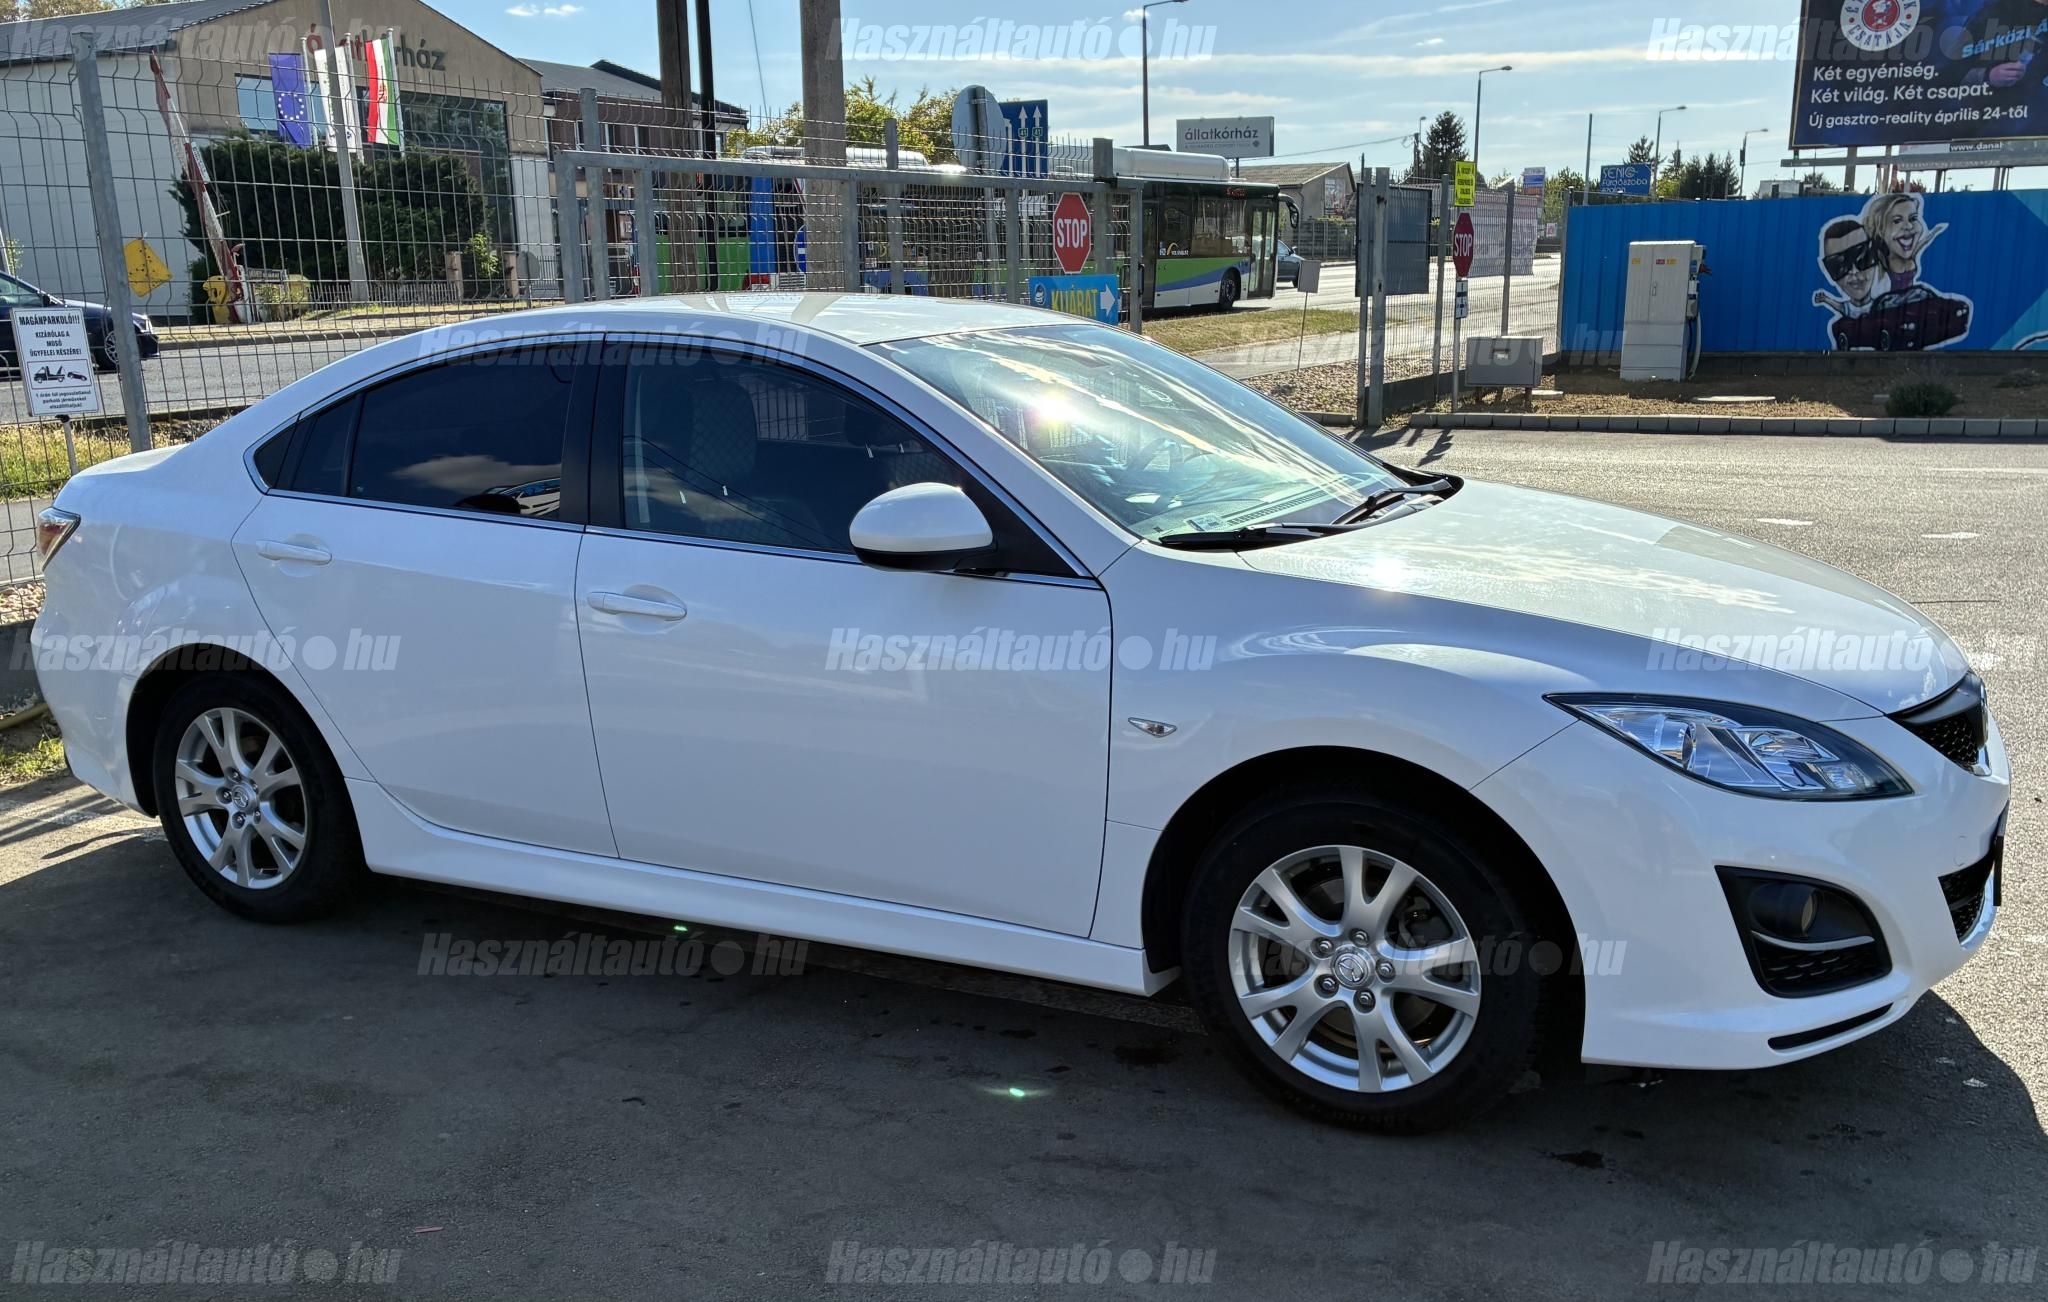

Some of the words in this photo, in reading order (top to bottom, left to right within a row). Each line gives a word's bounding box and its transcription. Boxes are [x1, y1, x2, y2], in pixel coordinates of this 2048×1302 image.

[1813, 66, 1842, 82] Két
[1845, 62, 1939, 83] egyéniség.
[1811, 88, 1839, 104] Két
[1843, 86, 1889, 105] világ.
[1893, 85, 1924, 101] Két
[1927, 82, 1994, 101] csapat.
[1808, 112, 1823, 128] Új
[1825, 110, 1932, 129] gasztro-reality
[1934, 107, 1980, 124] április
[1983, 105, 2029, 121] 24-től
[1184, 126, 1259, 141] állatkórház
[1056, 217, 1088, 249] STOP
[1454, 233, 1473, 257] STOP
[1051, 284, 1098, 317] KIJÁRAT
